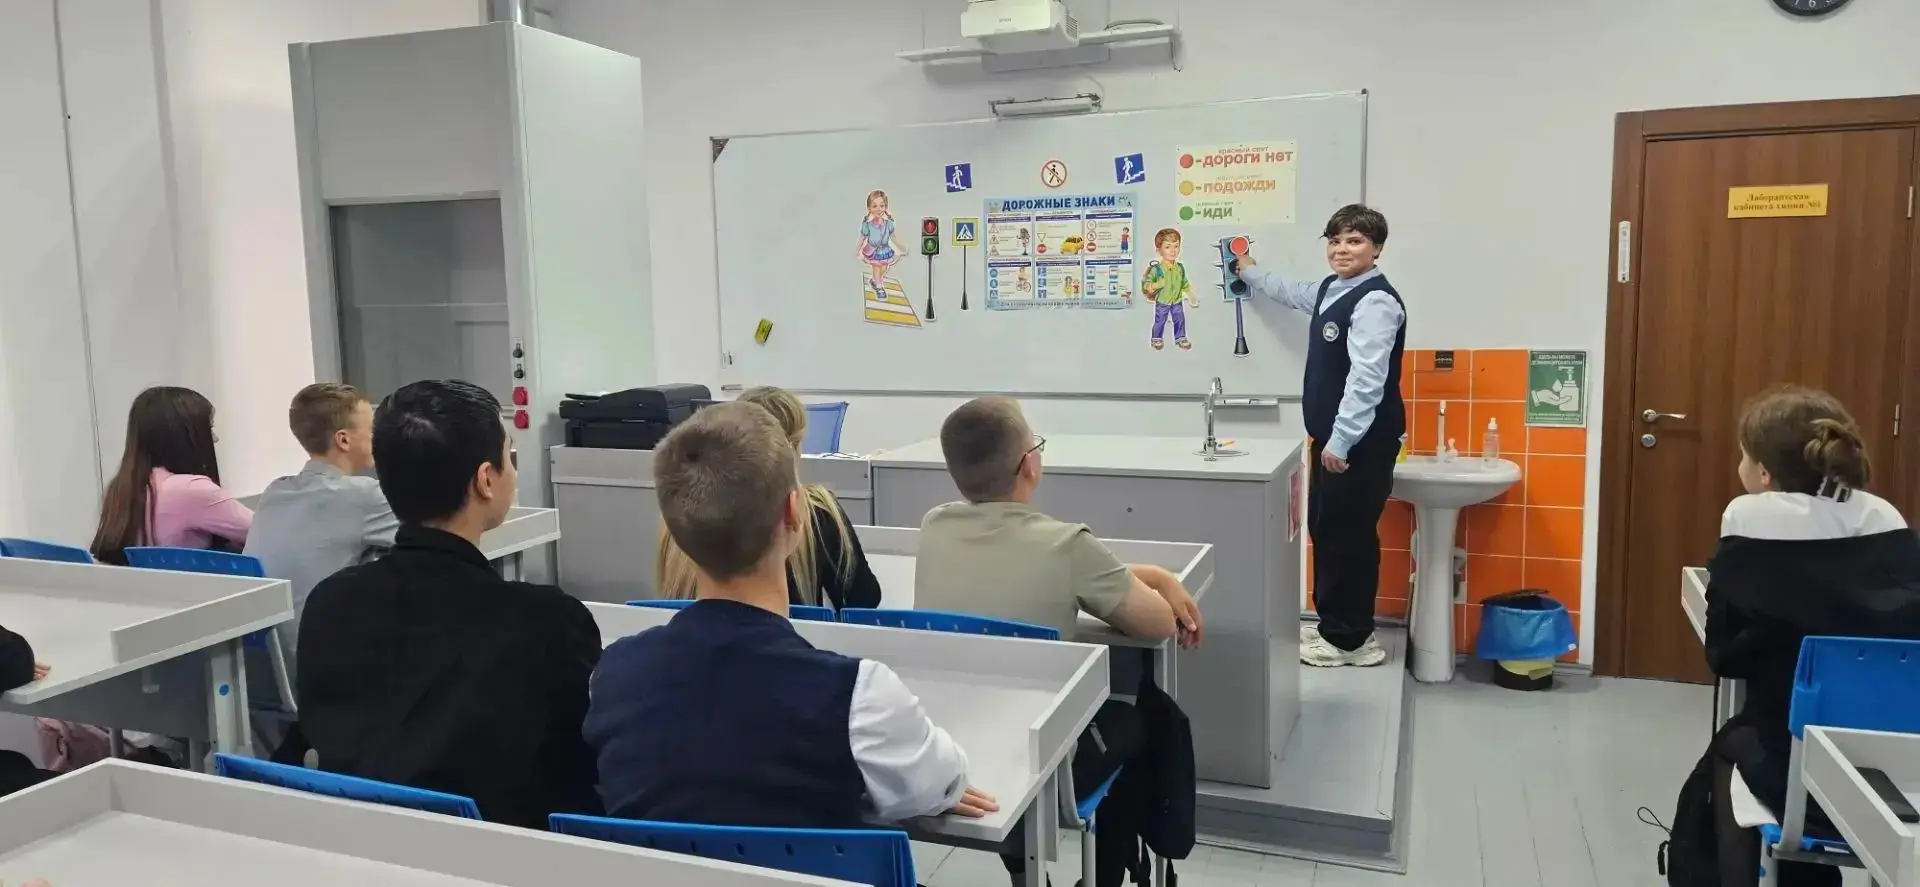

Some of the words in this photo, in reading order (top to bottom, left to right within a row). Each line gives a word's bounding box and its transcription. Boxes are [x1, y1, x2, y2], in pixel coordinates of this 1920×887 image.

[1265, 151, 1293, 162] нет
[1002, 198, 1071, 211] ДОРОЖНЫЕ
[1074, 196, 1115, 208] ЗНАКИ
